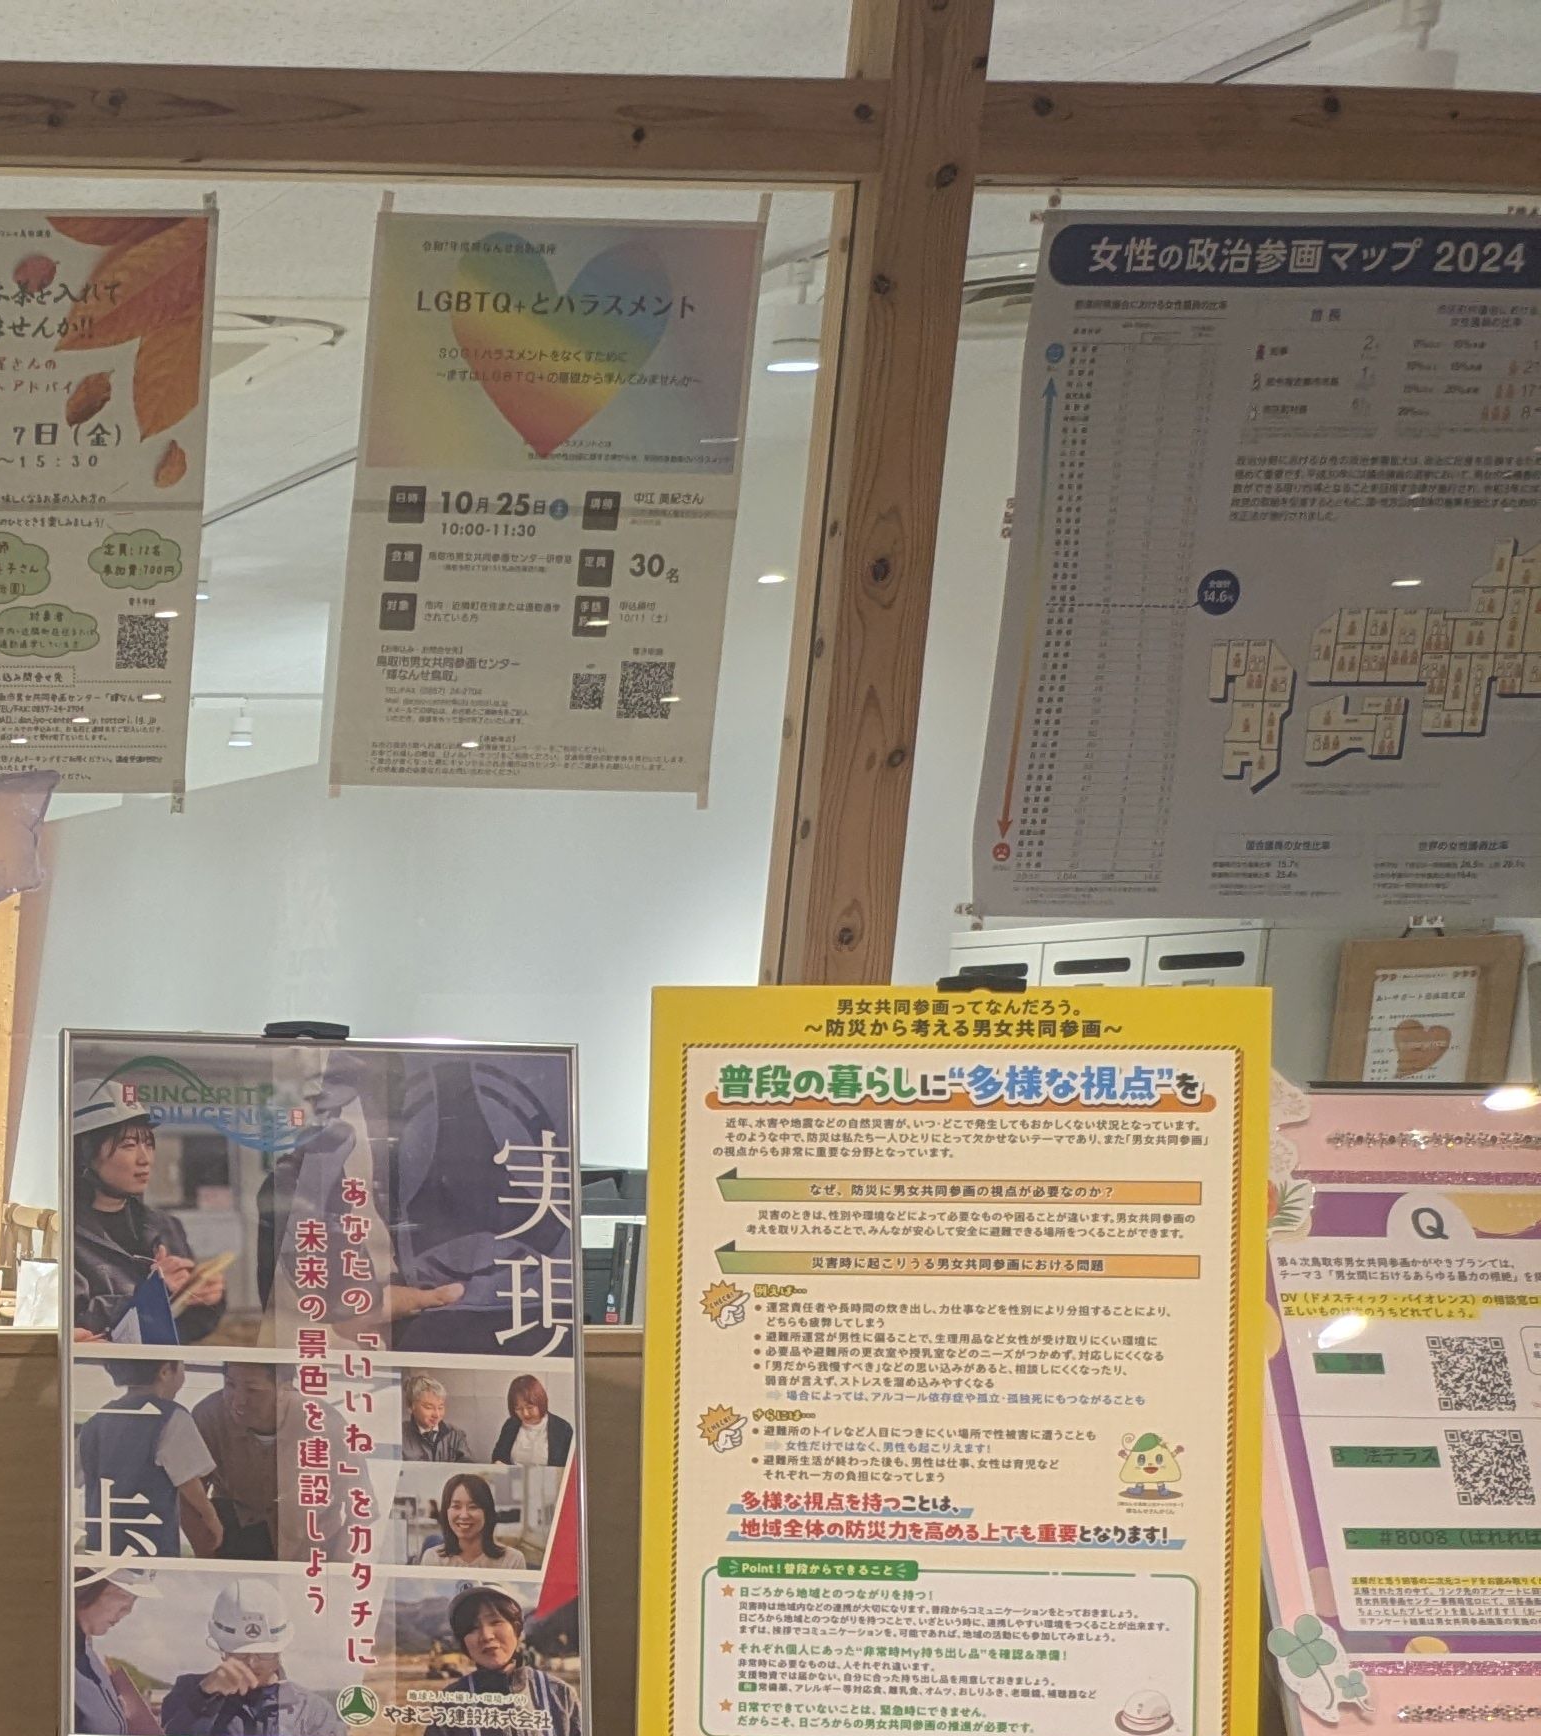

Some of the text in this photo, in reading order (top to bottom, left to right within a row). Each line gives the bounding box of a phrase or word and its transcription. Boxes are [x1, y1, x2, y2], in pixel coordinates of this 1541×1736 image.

[1088, 236, 1526, 274] 女性の政治参画マップ 2024
[441, 522, 537, 538] 10:00-11:30
[837, 998, 1082, 1017] 男女共同参画ってなんだろう。
[1411, 1207, 1449, 1240] Q
[493, 1129, 574, 1359] 実現
[294, 1218, 333, 1617] 未来の景色を建設しよう
[741, 1490, 960, 1514] 多様な視点を持つことは、
[383, 1706, 552, 1731] やまこう建設株式会社
